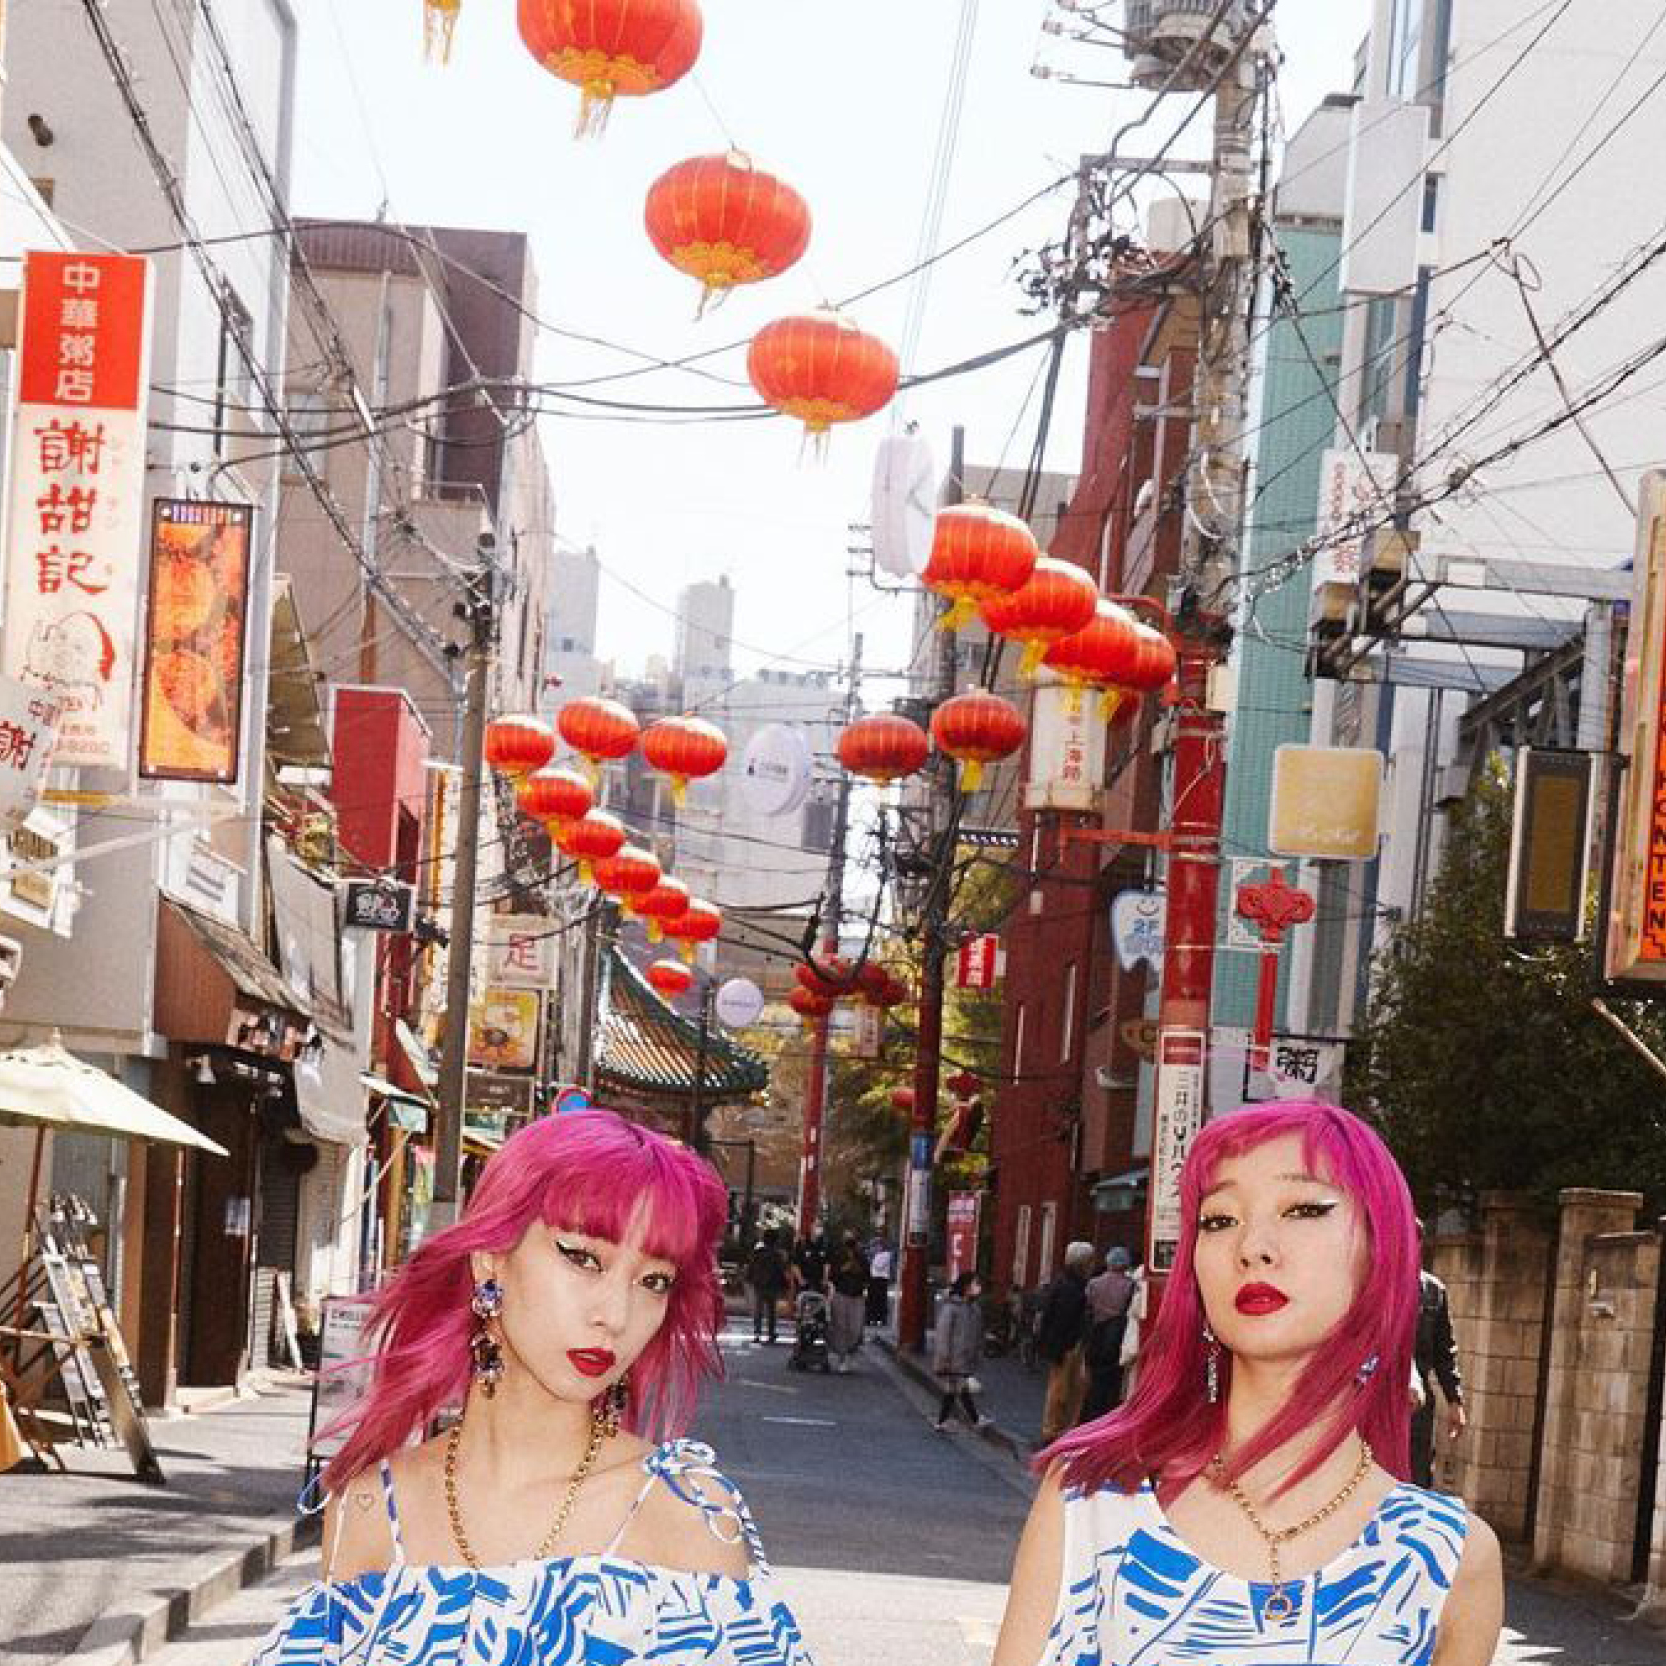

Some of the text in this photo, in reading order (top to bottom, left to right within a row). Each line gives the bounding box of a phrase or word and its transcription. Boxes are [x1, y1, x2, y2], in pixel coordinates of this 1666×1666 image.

[54, 261, 100, 403] 中華粥店
[33, 419, 108, 595] 謝甜記
